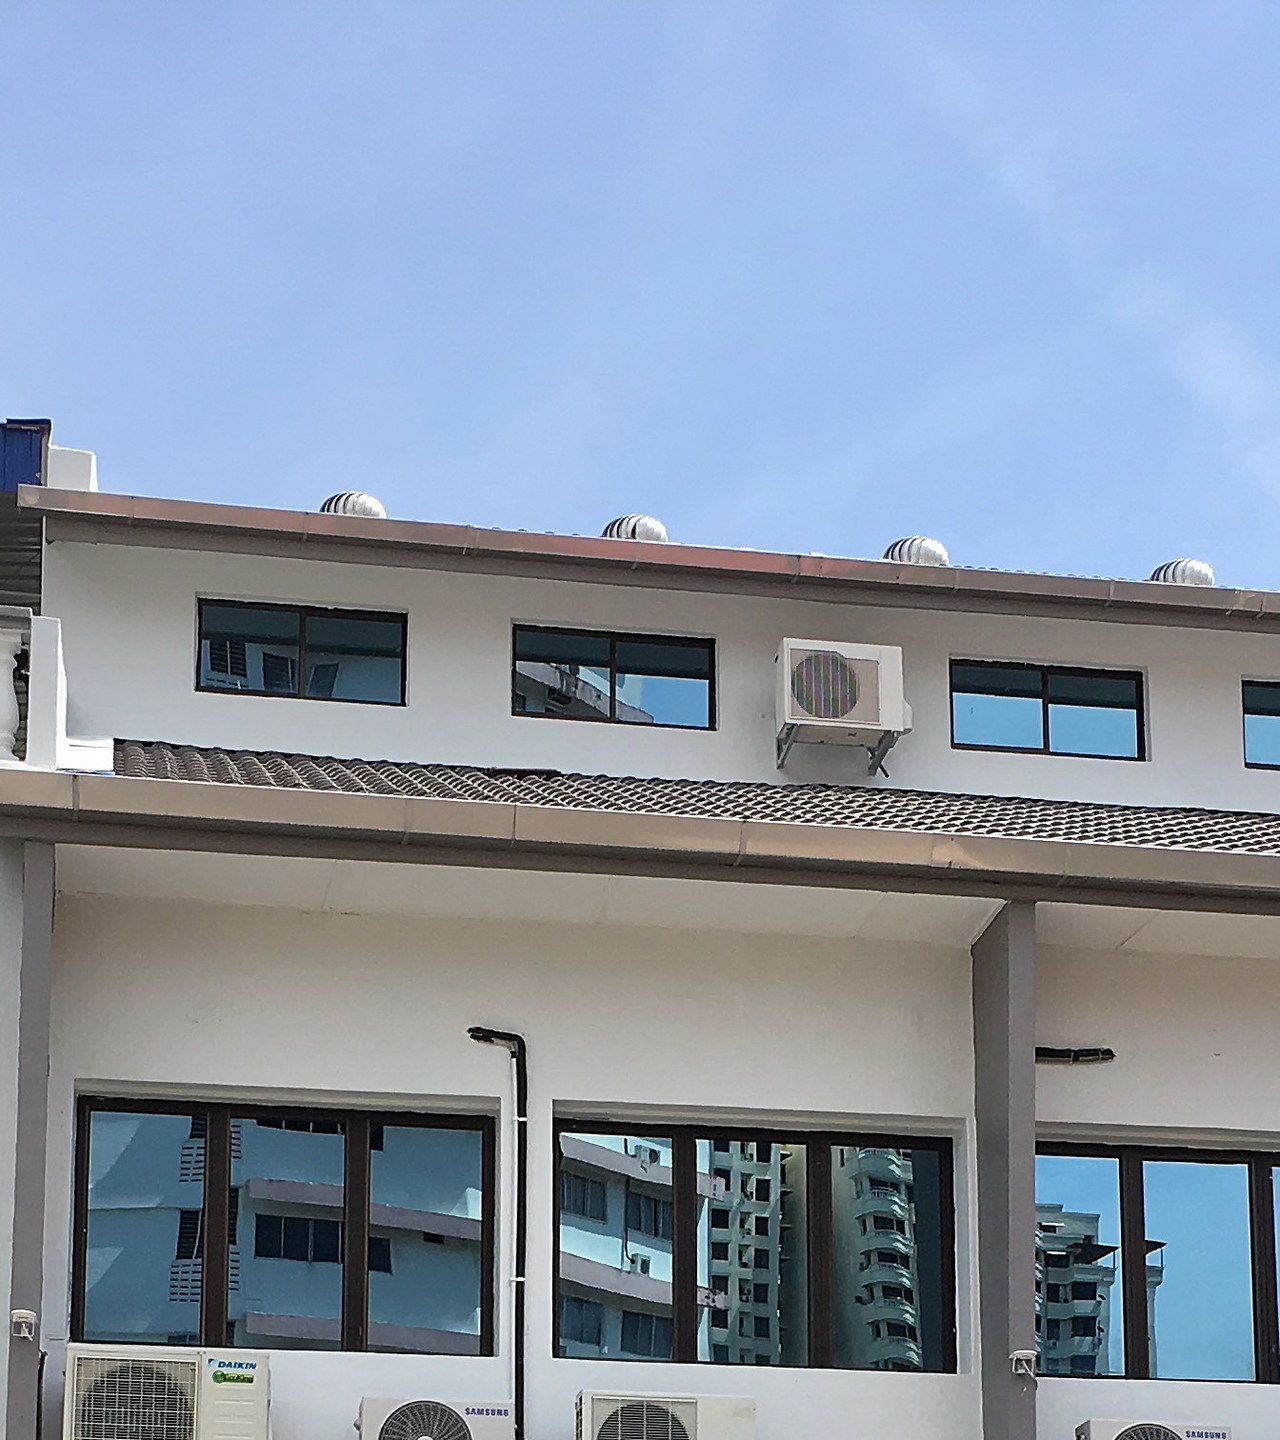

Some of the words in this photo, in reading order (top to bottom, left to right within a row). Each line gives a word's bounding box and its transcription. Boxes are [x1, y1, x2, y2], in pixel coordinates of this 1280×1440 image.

[218, 1361, 257, 1370] DAIKIN
[465, 1407, 509, 1417] SAMSUNG
[1185, 1430, 1227, 1440] SAMSUNG
